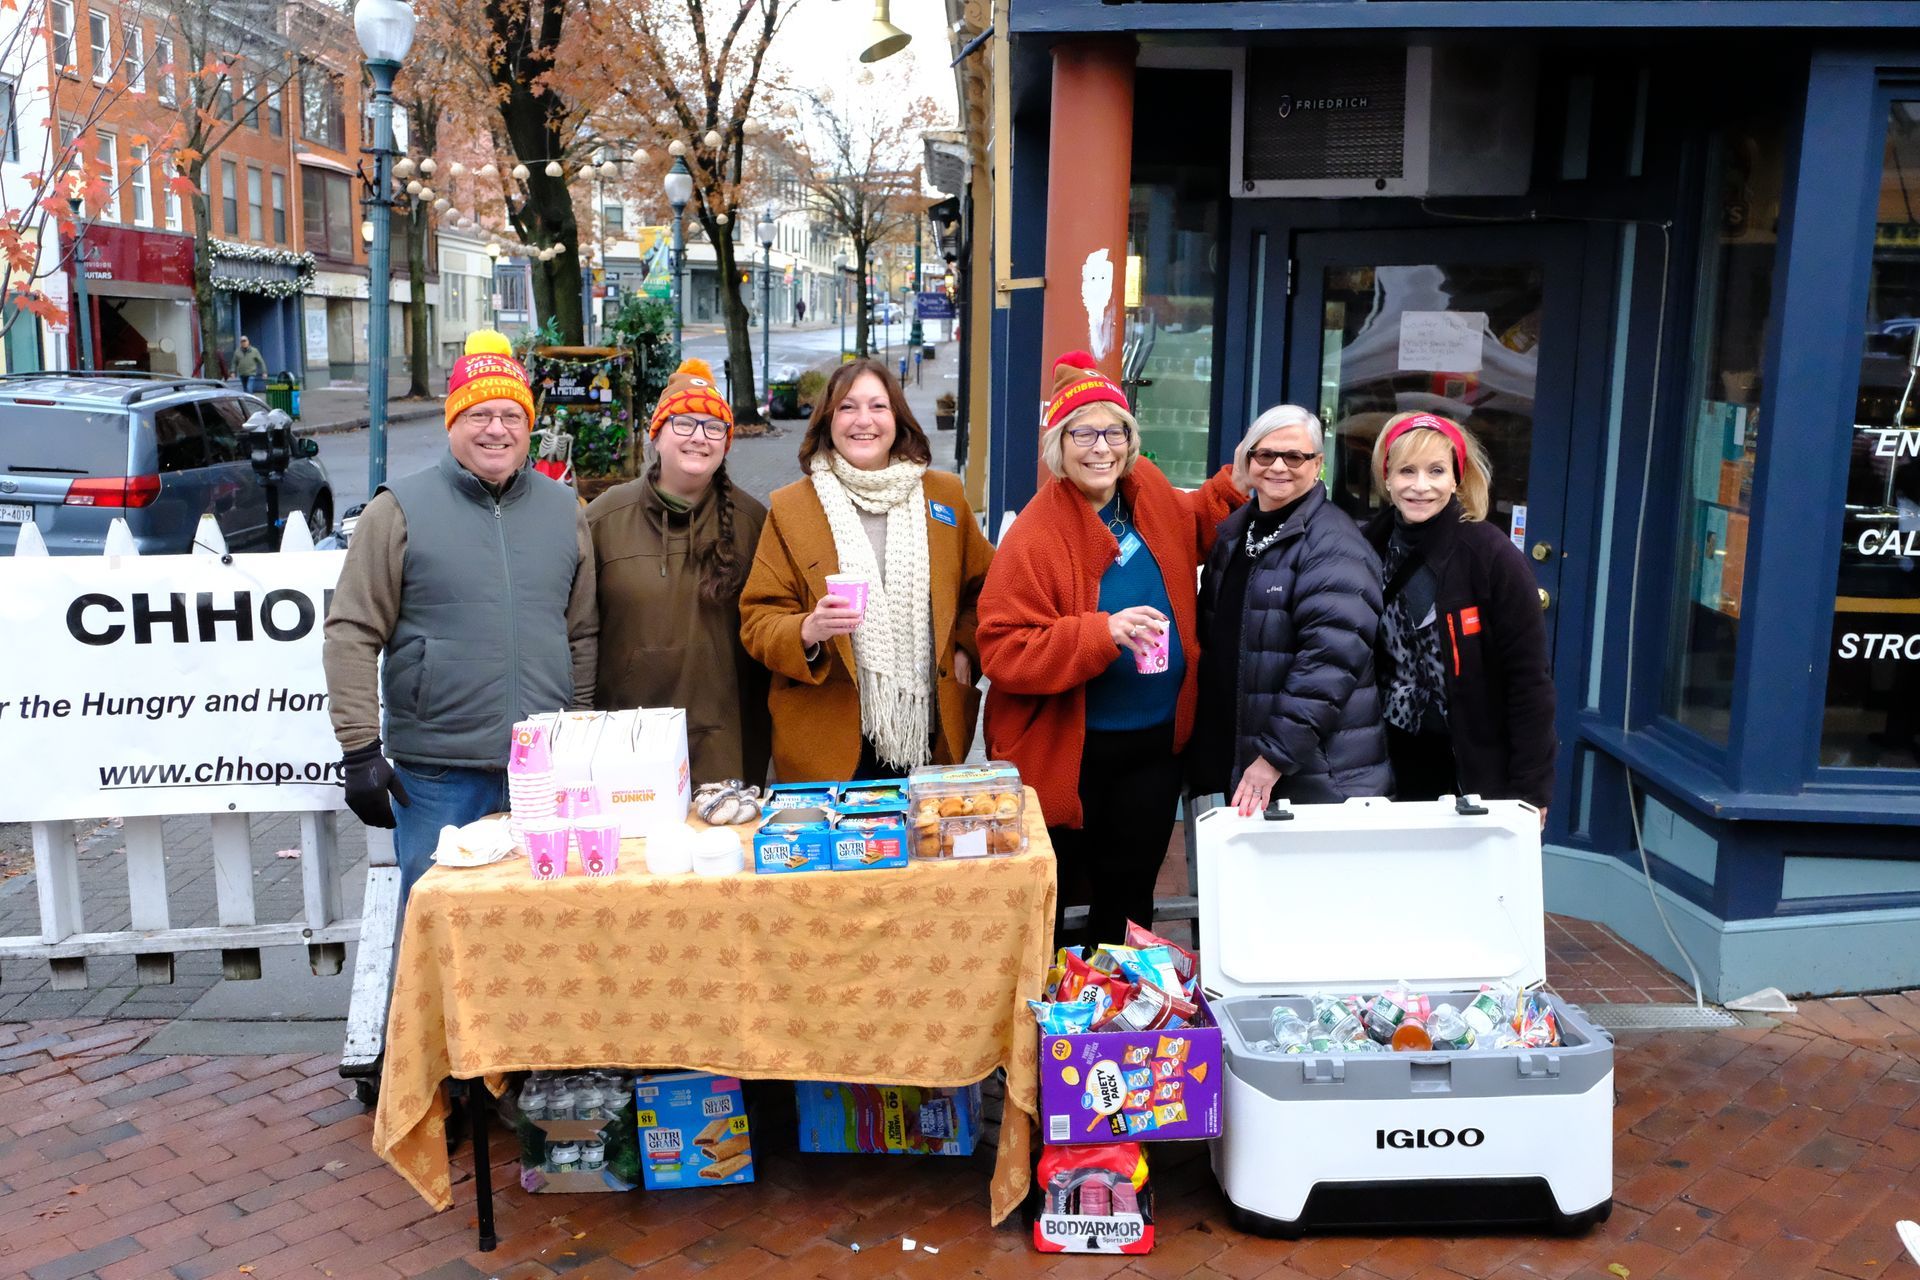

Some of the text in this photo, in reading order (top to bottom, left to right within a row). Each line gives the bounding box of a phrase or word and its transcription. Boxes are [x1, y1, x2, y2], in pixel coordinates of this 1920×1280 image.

[1296, 98, 1367, 110] FRIEDRICH
[557, 386, 586, 396] PICTURE
[1065, 381, 1105, 399] WOBBLE
[20, 694, 71, 719] the
[81, 691, 195, 720] Hungry
[204, 688, 260, 712] and
[763, 845, 788, 855] NUTRI
[839, 843, 864, 852] NUTRI
[840, 849, 865, 858] GRAIN
[764, 852, 789, 861] GRAIN
[1054, 1042, 1066, 1057] 40
[1096, 1069, 1113, 1108] VARIETY
[1107, 1075, 1120, 1099] PACK
[888, 1092, 898, 1109] 40
[733, 1120, 745, 1129] 48
[920, 1104, 930, 1134] JUICE
[648, 1131, 680, 1140] NUTRI
[888, 1120, 896, 1140] PACK
[893, 1114, 902, 1145] VARIETY
[649, 1138, 680, 1148] GRAIN
[1376, 1127, 1485, 1149] IGLOO
[1046, 1220, 1142, 1237] BODYARMOR
